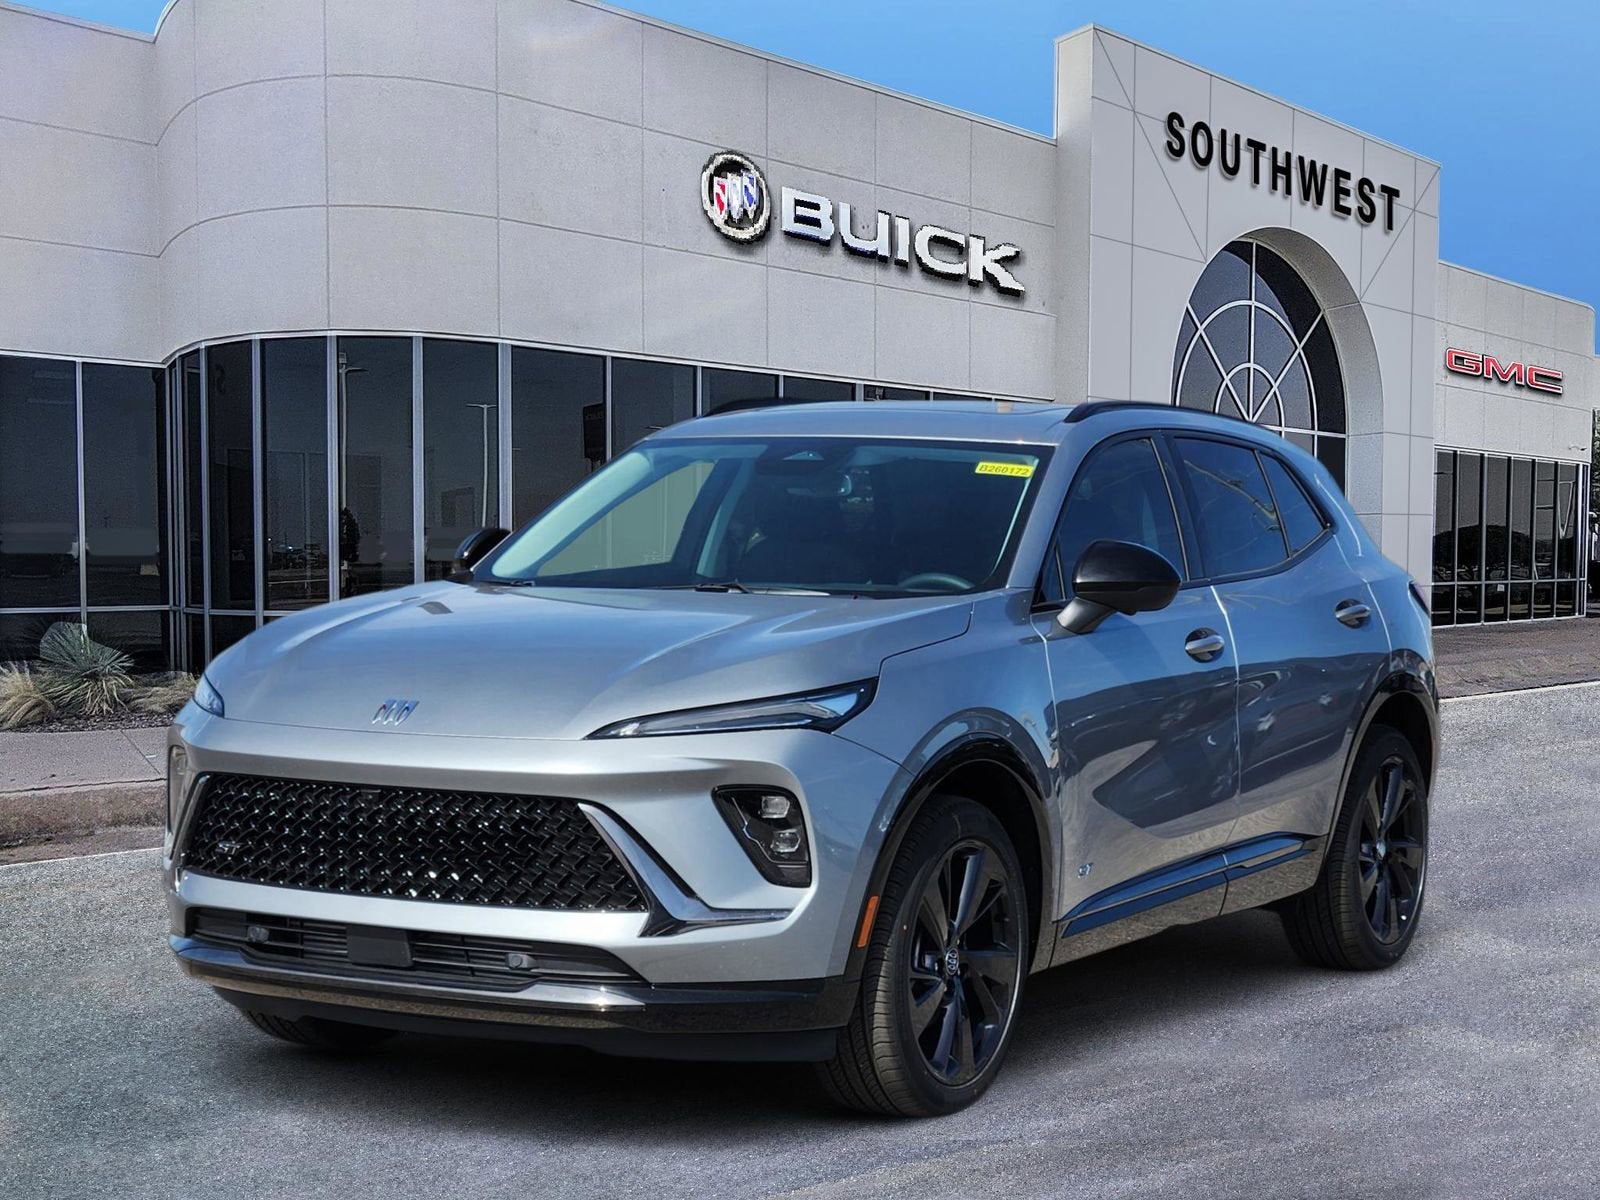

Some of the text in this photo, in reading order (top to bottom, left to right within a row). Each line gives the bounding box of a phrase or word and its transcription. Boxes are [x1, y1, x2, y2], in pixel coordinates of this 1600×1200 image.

[1166, 111, 1400, 231] SOUTHWEST
[781, 186, 1025, 296] BUICK
[1446, 348, 1563, 394] GMC
[979, 464, 1030, 475] B260172
